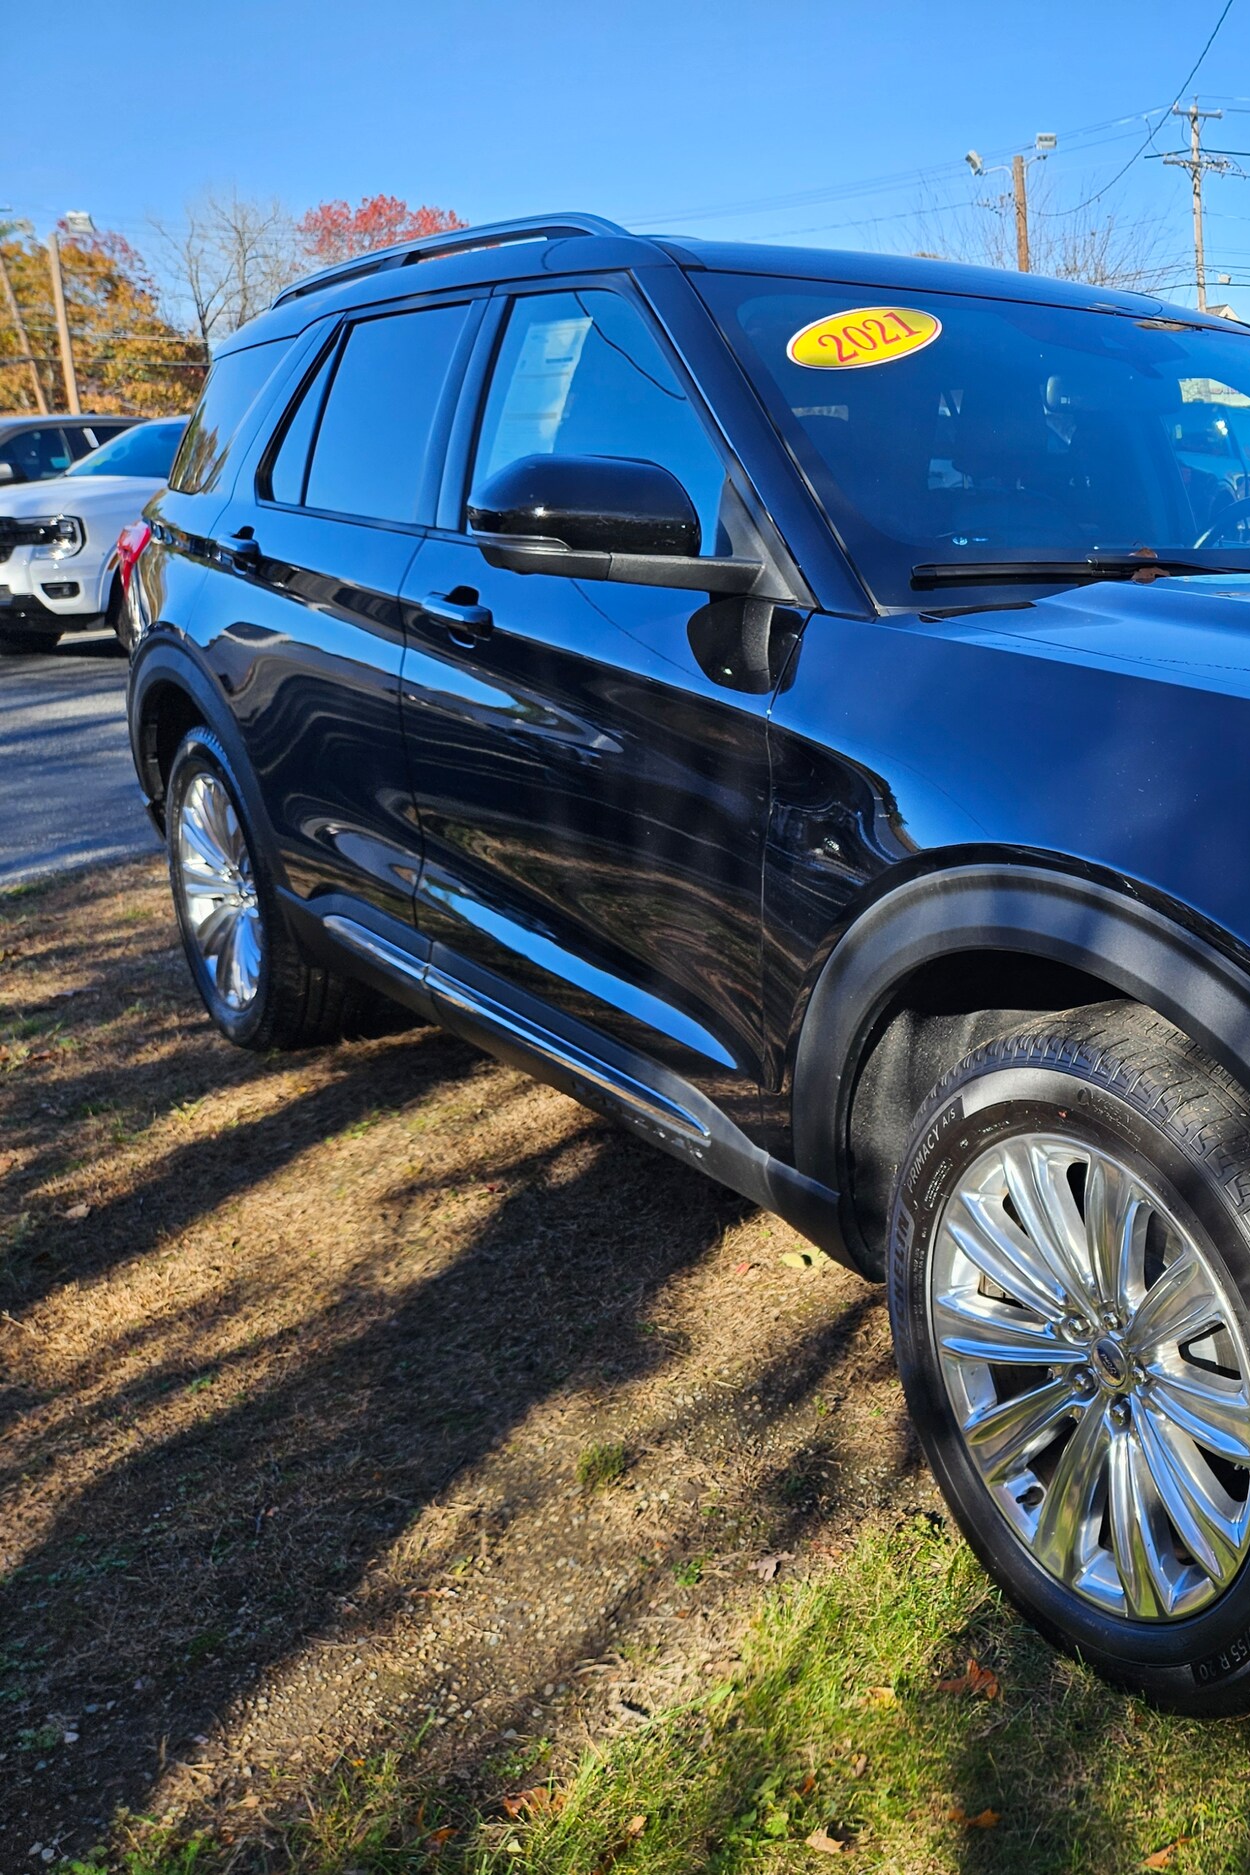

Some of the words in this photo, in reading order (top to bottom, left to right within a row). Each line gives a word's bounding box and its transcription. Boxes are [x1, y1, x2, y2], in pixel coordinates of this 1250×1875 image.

[818, 312, 921, 362] 2021
[907, 1124, 940, 1193] PRIMACY
[942, 1108, 956, 1128] A/S
[1200, 1660, 1217, 1680] 20
[1219, 1653, 1231, 1670] R
